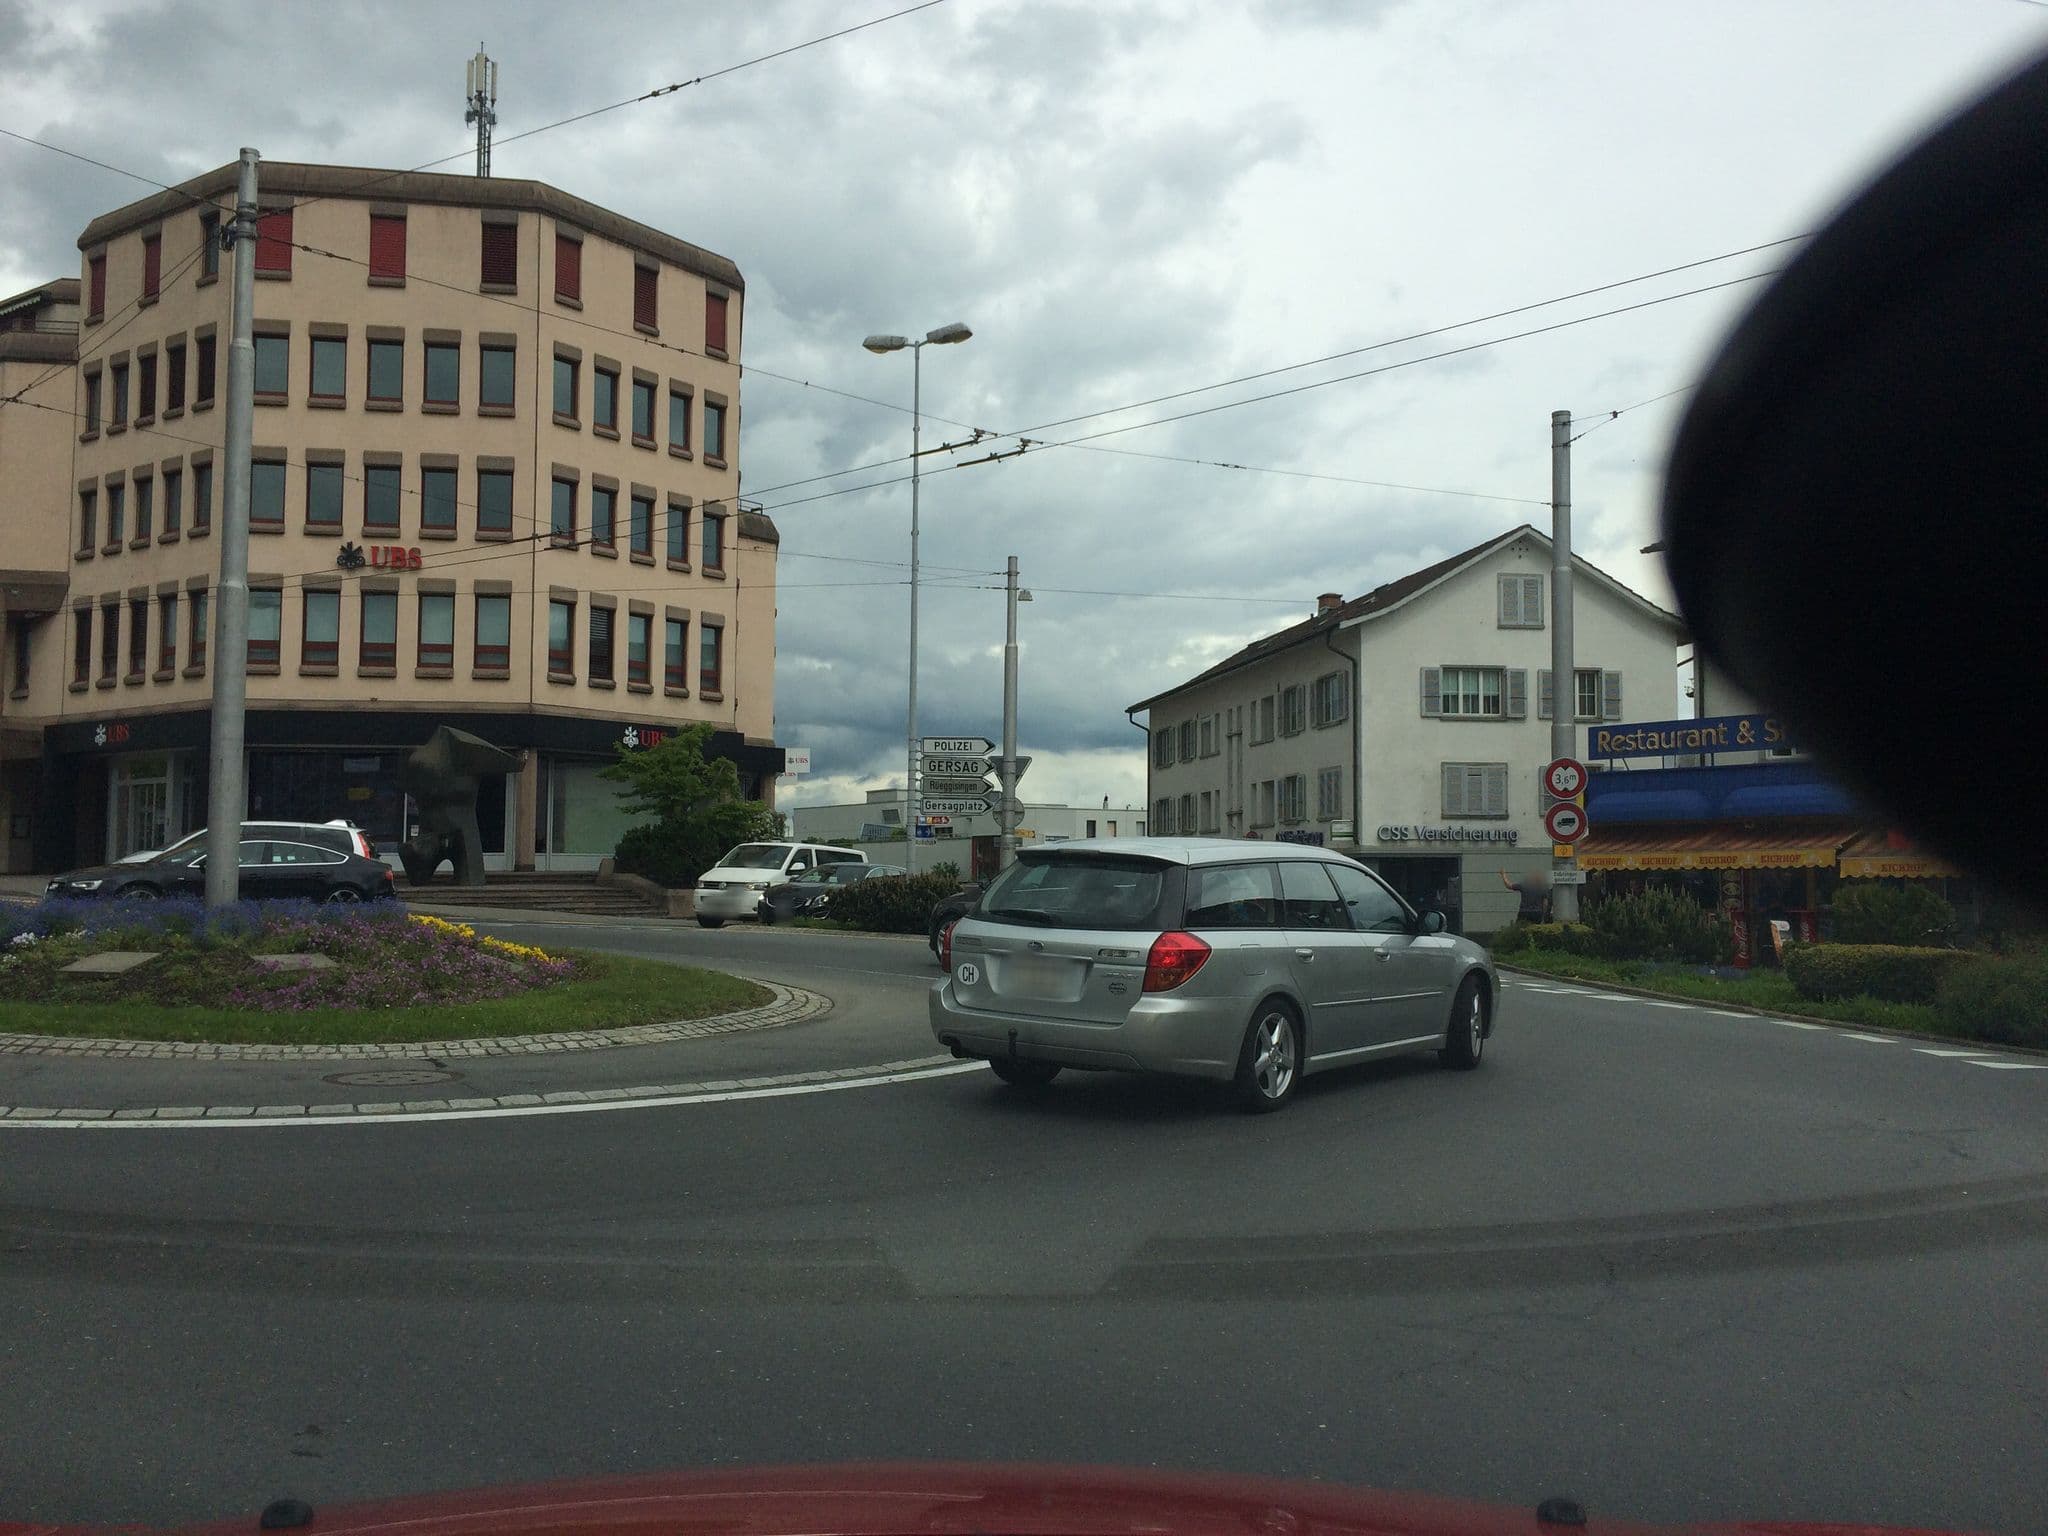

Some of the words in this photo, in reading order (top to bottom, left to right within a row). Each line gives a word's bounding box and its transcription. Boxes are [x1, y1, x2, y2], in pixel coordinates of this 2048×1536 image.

[371, 545, 422, 569] UBS
[1597, 724, 1728, 753] Restaurant
[1736, 719, 1754, 744] &
[934, 741, 972, 751] POLIZEI
[928, 760, 978, 773] GERSAG
[925, 801, 983, 813] Gersagplatz
[1377, 825, 1409, 841] CSS
[1413, 825, 1518, 846] Versicherung
[1699, 856, 1738, 865] EICHHOF
[1760, 854, 1801, 863] EICHHOF
[962, 966, 975, 982] CH
